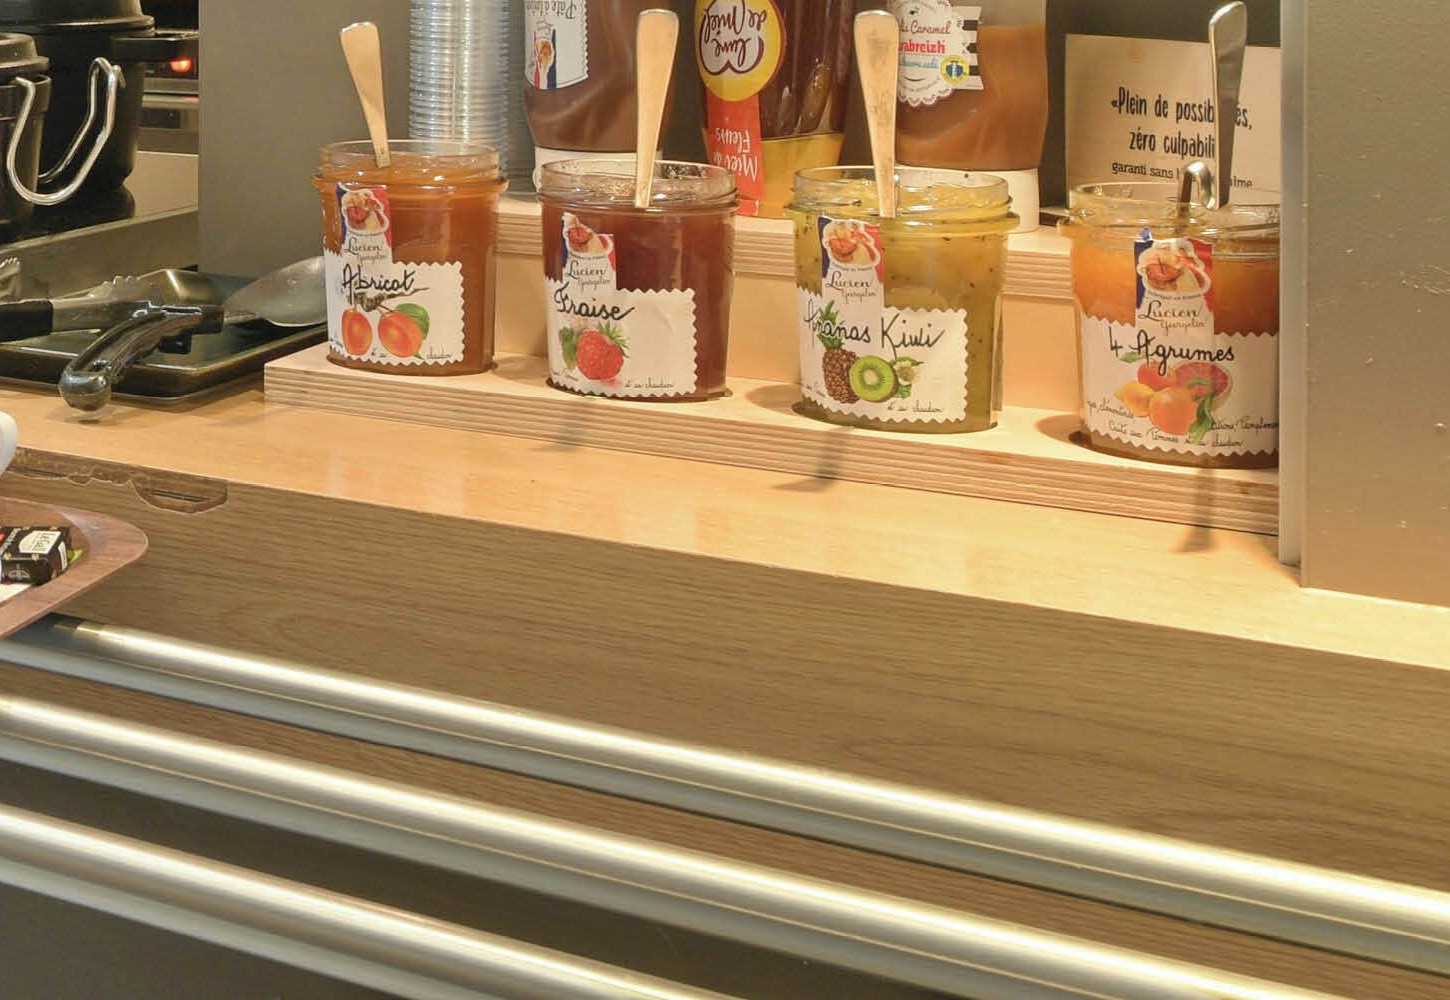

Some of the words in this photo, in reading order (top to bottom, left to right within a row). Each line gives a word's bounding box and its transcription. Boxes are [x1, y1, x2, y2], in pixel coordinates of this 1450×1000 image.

[910, 19, 951, 34] Caramel
[1155, 94, 1168, 118] de
[715, 128, 750, 153] Fleurs
[1129, 127, 1156, 153] zéro
[1163, 131, 1215, 160] culpabili
[1111, 161, 1147, 175] garanti
[1149, 166, 1174, 179] sans
[343, 237, 384, 256] Lucien
[565, 260, 606, 280] Lucien
[825, 271, 873, 292] Lucien
[342, 263, 416, 305] Abricot
[554, 281, 635, 321] Fraise
[1138, 300, 1201, 321] Lucien
[881, 312, 945, 360] Kiwi
[1108, 326, 1123, 358] 4
[1128, 329, 1235, 377] Agrumes
